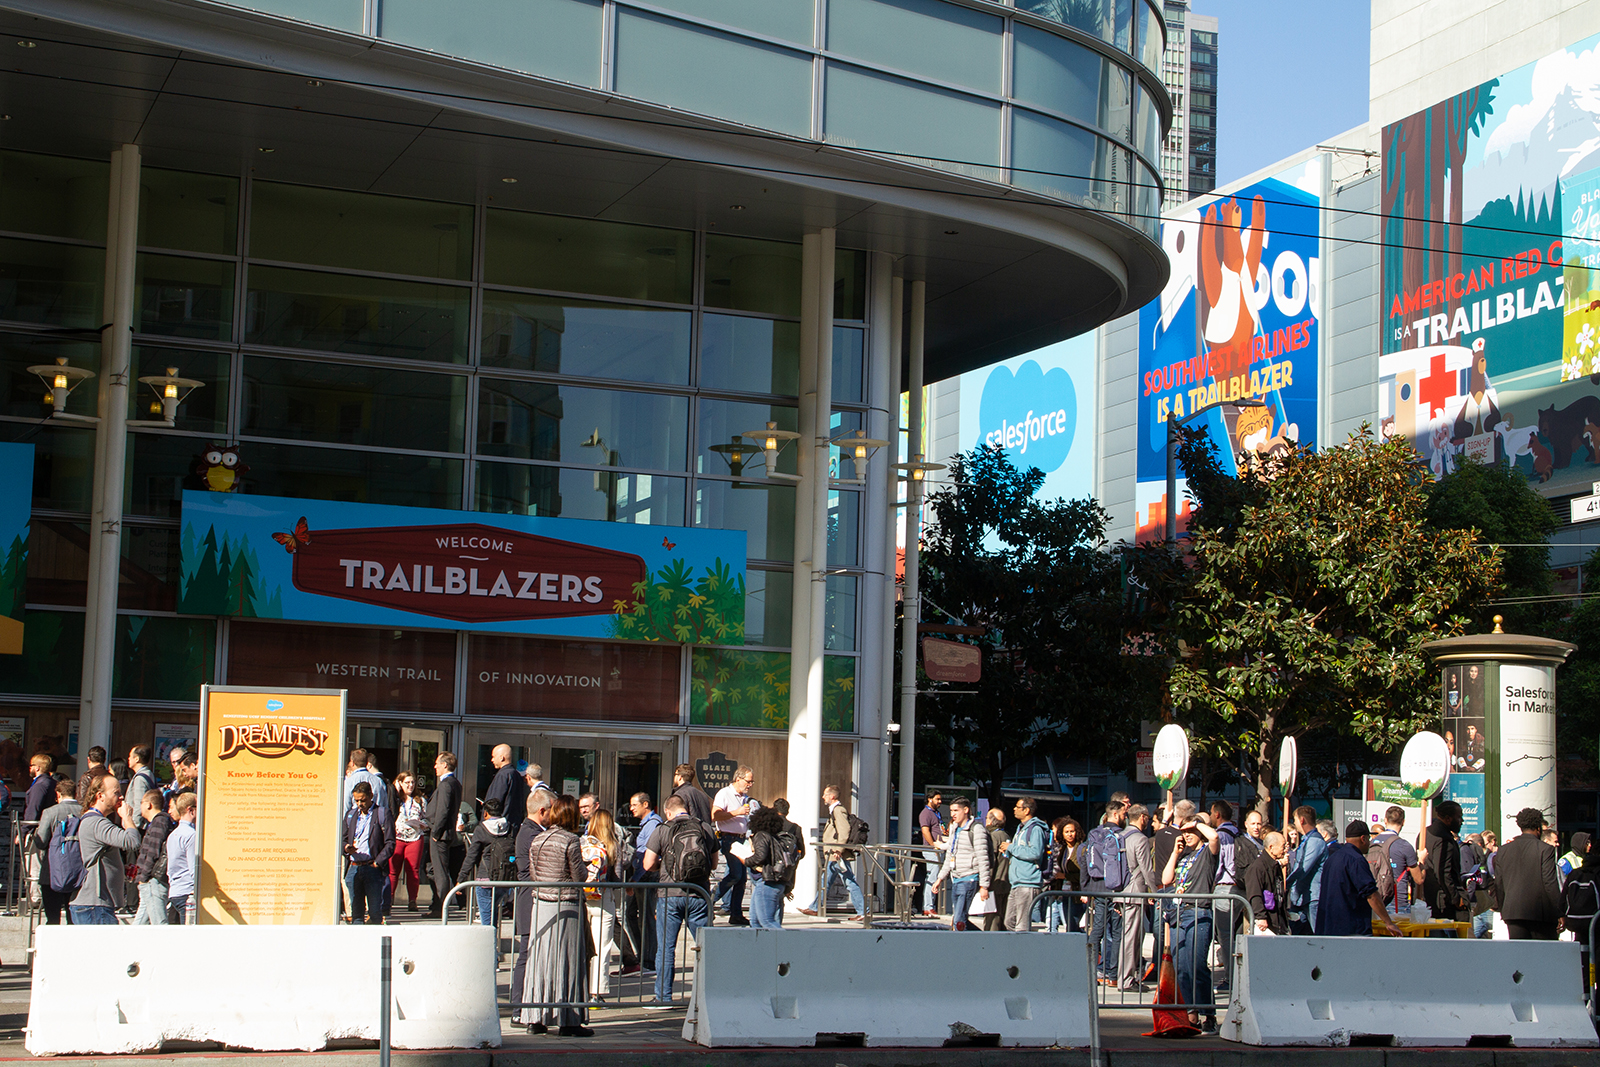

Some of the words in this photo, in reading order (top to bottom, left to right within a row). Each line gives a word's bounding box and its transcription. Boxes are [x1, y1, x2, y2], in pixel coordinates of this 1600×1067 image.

[1390, 262, 1494, 319] AMERICAN
[1502, 248, 1542, 284] RED
[1394, 327, 1402, 341] IS
[1403, 325, 1411, 338] A
[1144, 345, 1236, 397] SOUTHWEST
[1157, 398, 1172, 424] IS
[1174, 394, 1185, 418] A
[1187, 360, 1293, 410] TRAILBLAZER
[985, 408, 1066, 454] salesforce
[435, 537, 513, 554] WELCOME
[339, 559, 604, 604] TRAILBLAZERS
[316, 663, 390, 681] WESTERN
[397, 667, 441, 682] TRAIL
[479, 671, 501, 683] OF
[506, 672, 601, 688] INNOVATION
[1509, 700, 1520, 712] in
[218, 722, 328, 760] DREAMFEST
